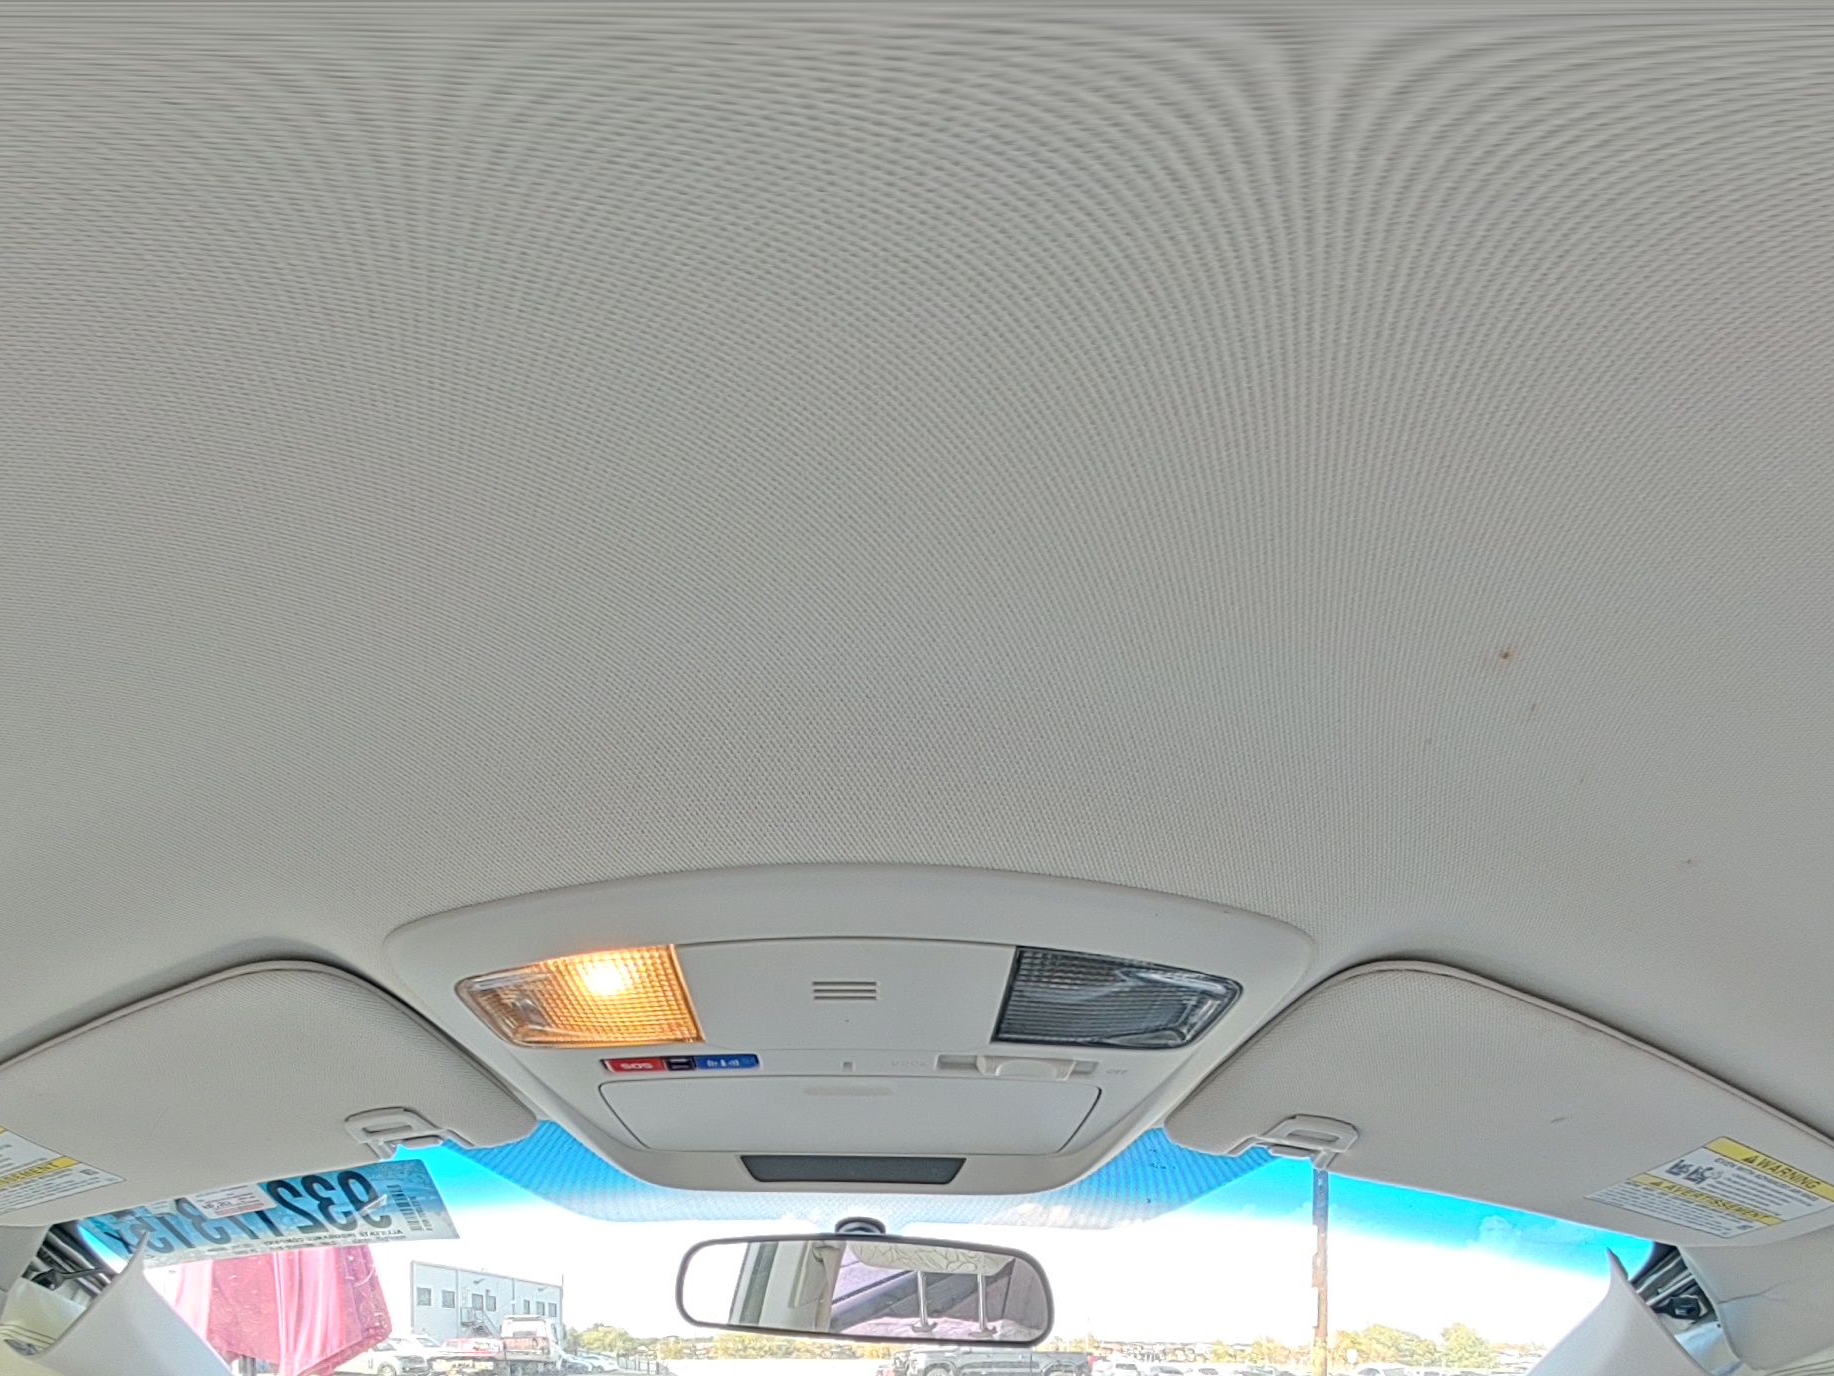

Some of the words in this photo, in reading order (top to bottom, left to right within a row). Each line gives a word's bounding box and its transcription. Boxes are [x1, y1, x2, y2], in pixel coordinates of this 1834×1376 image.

[620, 1061, 653, 1070] SOS
[1756, 1159, 1822, 1189] WARNING
[1664, 1183, 1770, 1220] AVERTISSEMENT
